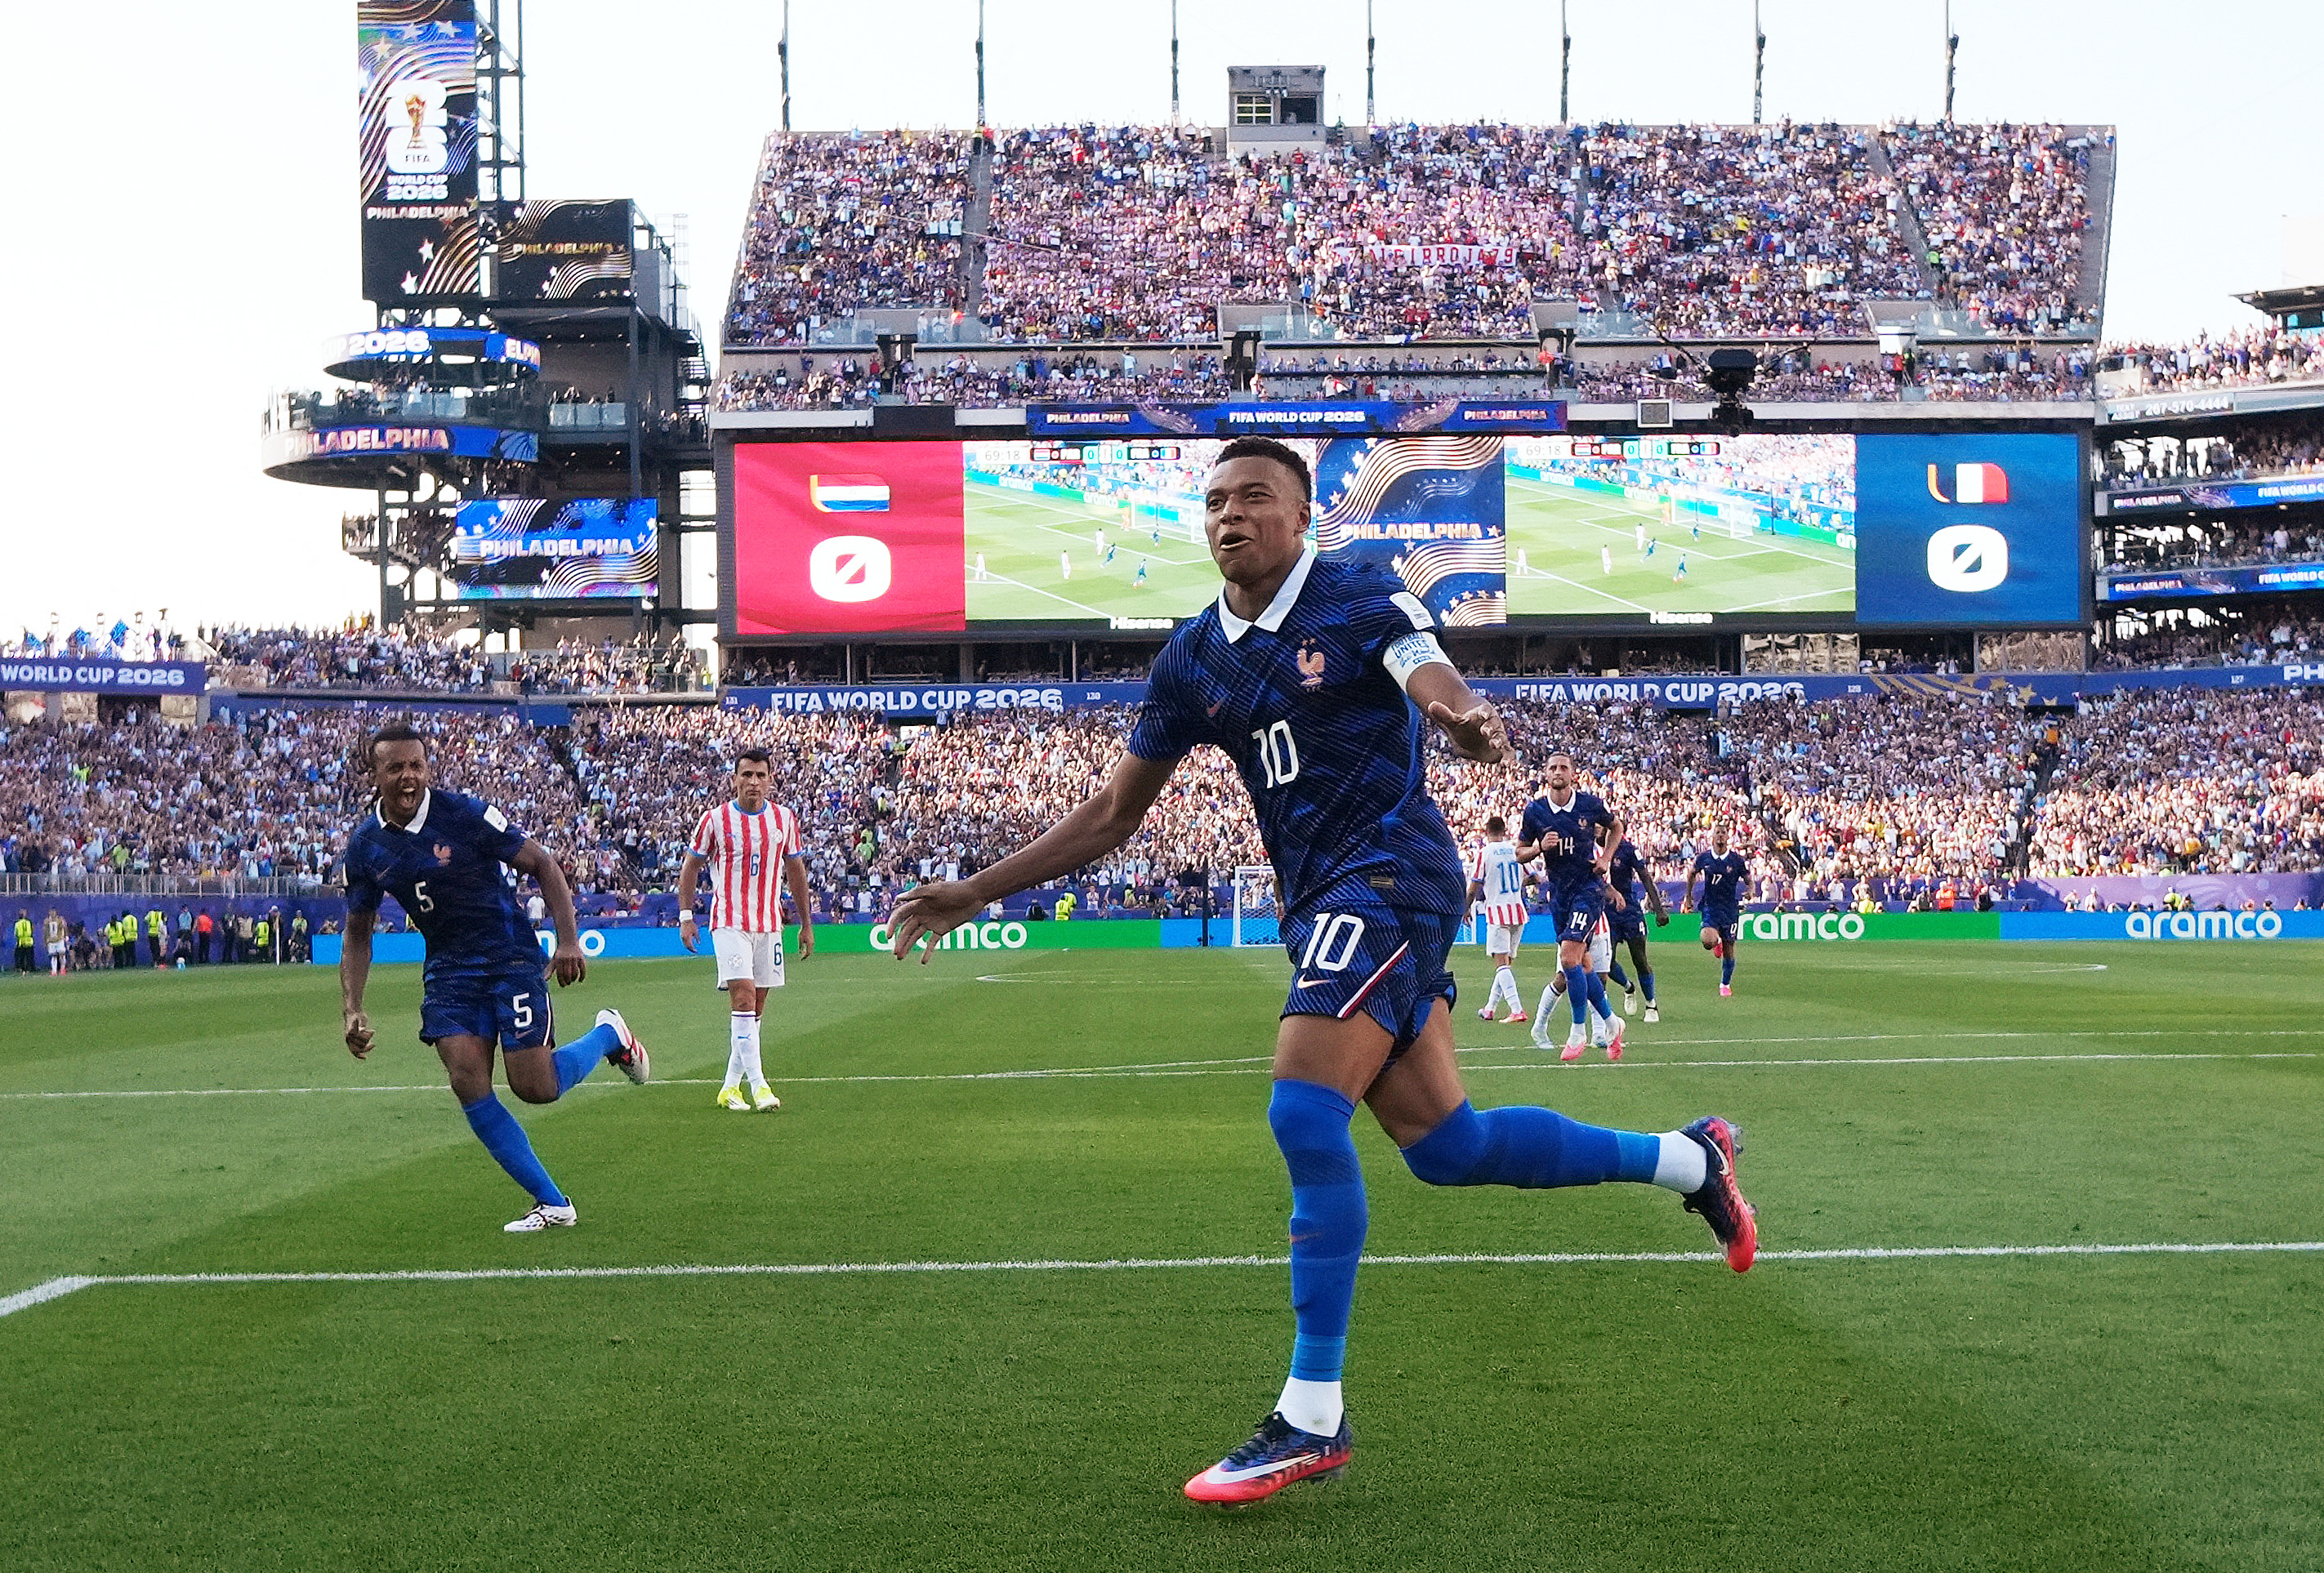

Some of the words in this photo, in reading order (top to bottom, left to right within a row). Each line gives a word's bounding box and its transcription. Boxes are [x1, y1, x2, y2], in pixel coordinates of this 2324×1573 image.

[405, 154, 430, 163] FIFA
[387, 174, 426, 185] WORLD
[426, 174, 448, 185] CUP
[386, 185, 448, 201] 2026
[367, 206, 469, 220] PHILADELPHIA
[349, 330, 430, 357] 2026
[1046, 412, 1131, 424] PHILADELPHIA
[1229, 412, 1256, 423] FIFA
[1256, 412, 1299, 423] WORLD
[1299, 412, 1323, 422] CUP
[1323, 411, 1366, 422] 2026
[1464, 409, 1547, 421] PHILADELPHIA
[984, 450, 1020, 461] 69:18
[1525, 445, 1562, 456] 69:18
[1340, 524, 1483, 540] PHILADELPHIA
[480, 539, 636, 557] PHILADELPHIA
[2258, 573, 2281, 585] FIFA
[2281, 570, 2317, 583] WORLD
[1110, 617, 1174, 630] Hisense
[1650, 612, 1713, 624] Hisense
[1, 664, 73, 684] WORLD
[75, 666, 115, 684] CUP
[117, 667, 185, 687] 2026
[771, 693, 824, 712] FIFA
[827, 691, 918, 711] WORLD
[921, 690, 972, 711] CUP
[975, 688, 1063, 711] 2026
[1515, 684, 1568, 702] FIFA
[1572, 683, 1660, 702] WORLD
[1665, 683, 1715, 702] CUP
[1251, 720, 1299, 789] 10
[1559, 836, 1575, 857] 14
[750, 853, 760, 876] 6
[1497, 861, 1519, 894] 10
[1711, 873, 1723, 885] 17
[414, 880, 434, 913] 5
[1570, 911, 1589, 931] 14
[1737, 912, 1865, 940] ramco
[2126, 911, 2282, 938] aramco
[870, 921, 1027, 951] amco
[1300, 912, 1365, 972] 10
[774, 942, 783, 966] 6
[512, 992, 533, 1029] 5
